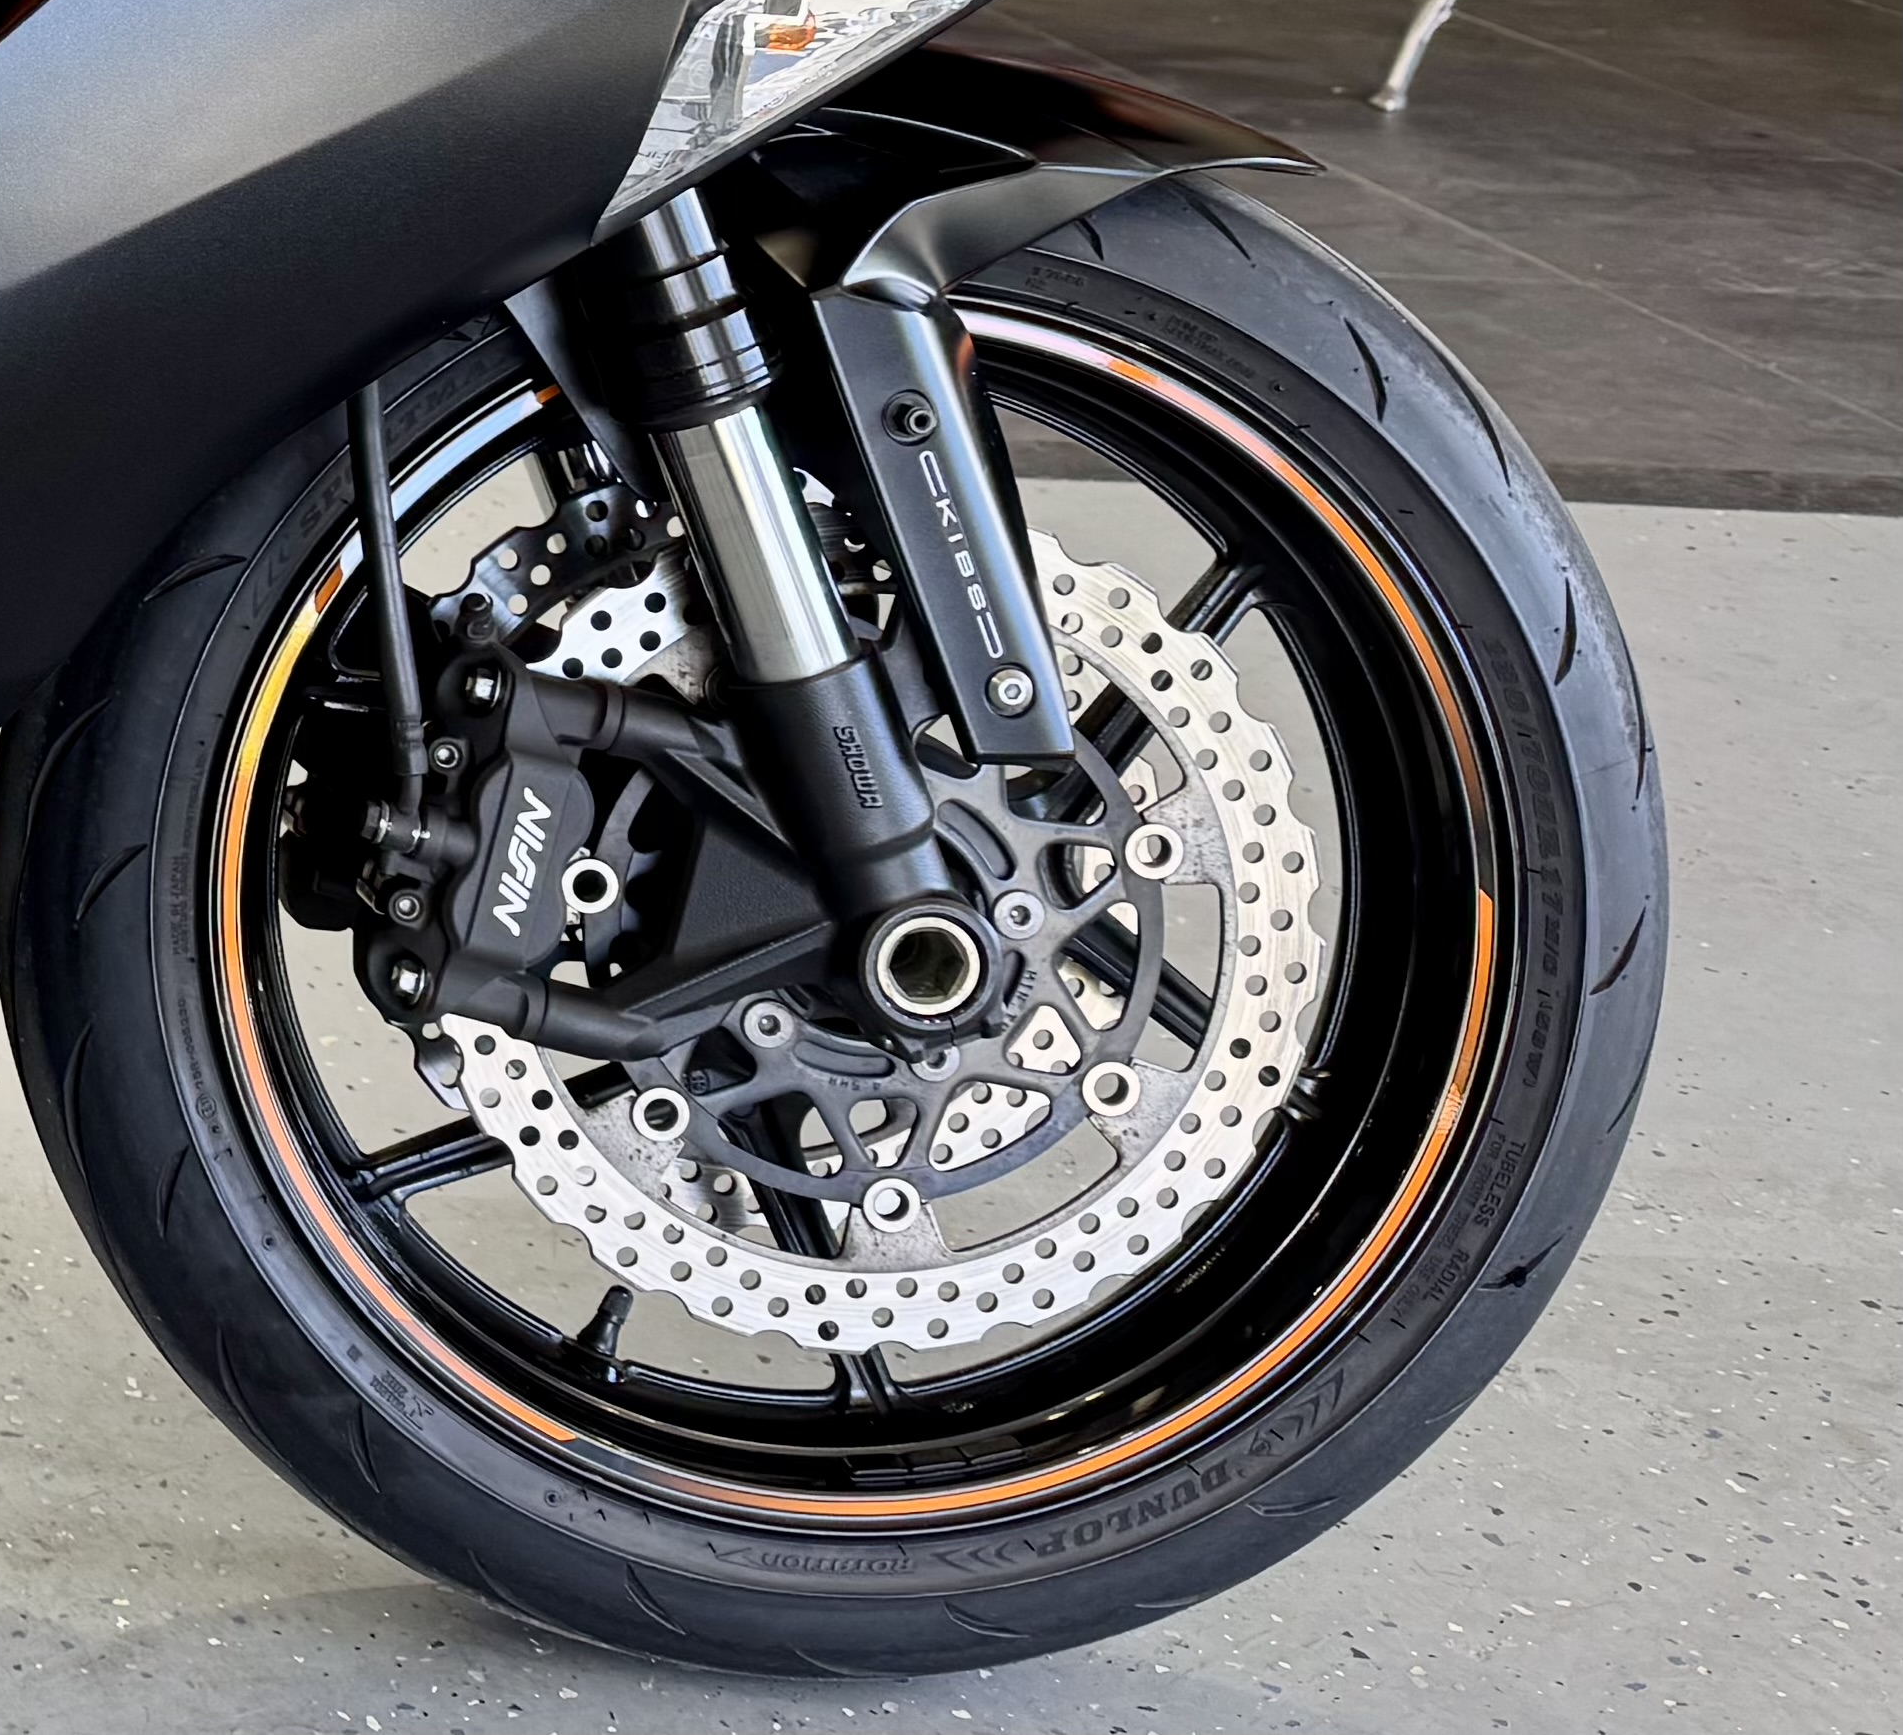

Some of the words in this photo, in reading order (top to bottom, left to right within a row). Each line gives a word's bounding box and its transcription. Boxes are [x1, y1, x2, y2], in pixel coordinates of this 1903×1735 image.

[833, 725, 885, 810] SHOWA
[1473, 1139, 1526, 1229] TUBELESS
[1422, 1247, 1469, 1302] RADIAL
[1038, 1460, 1231, 1560] DUNLOP
[759, 1551, 914, 1574] ROTATION
